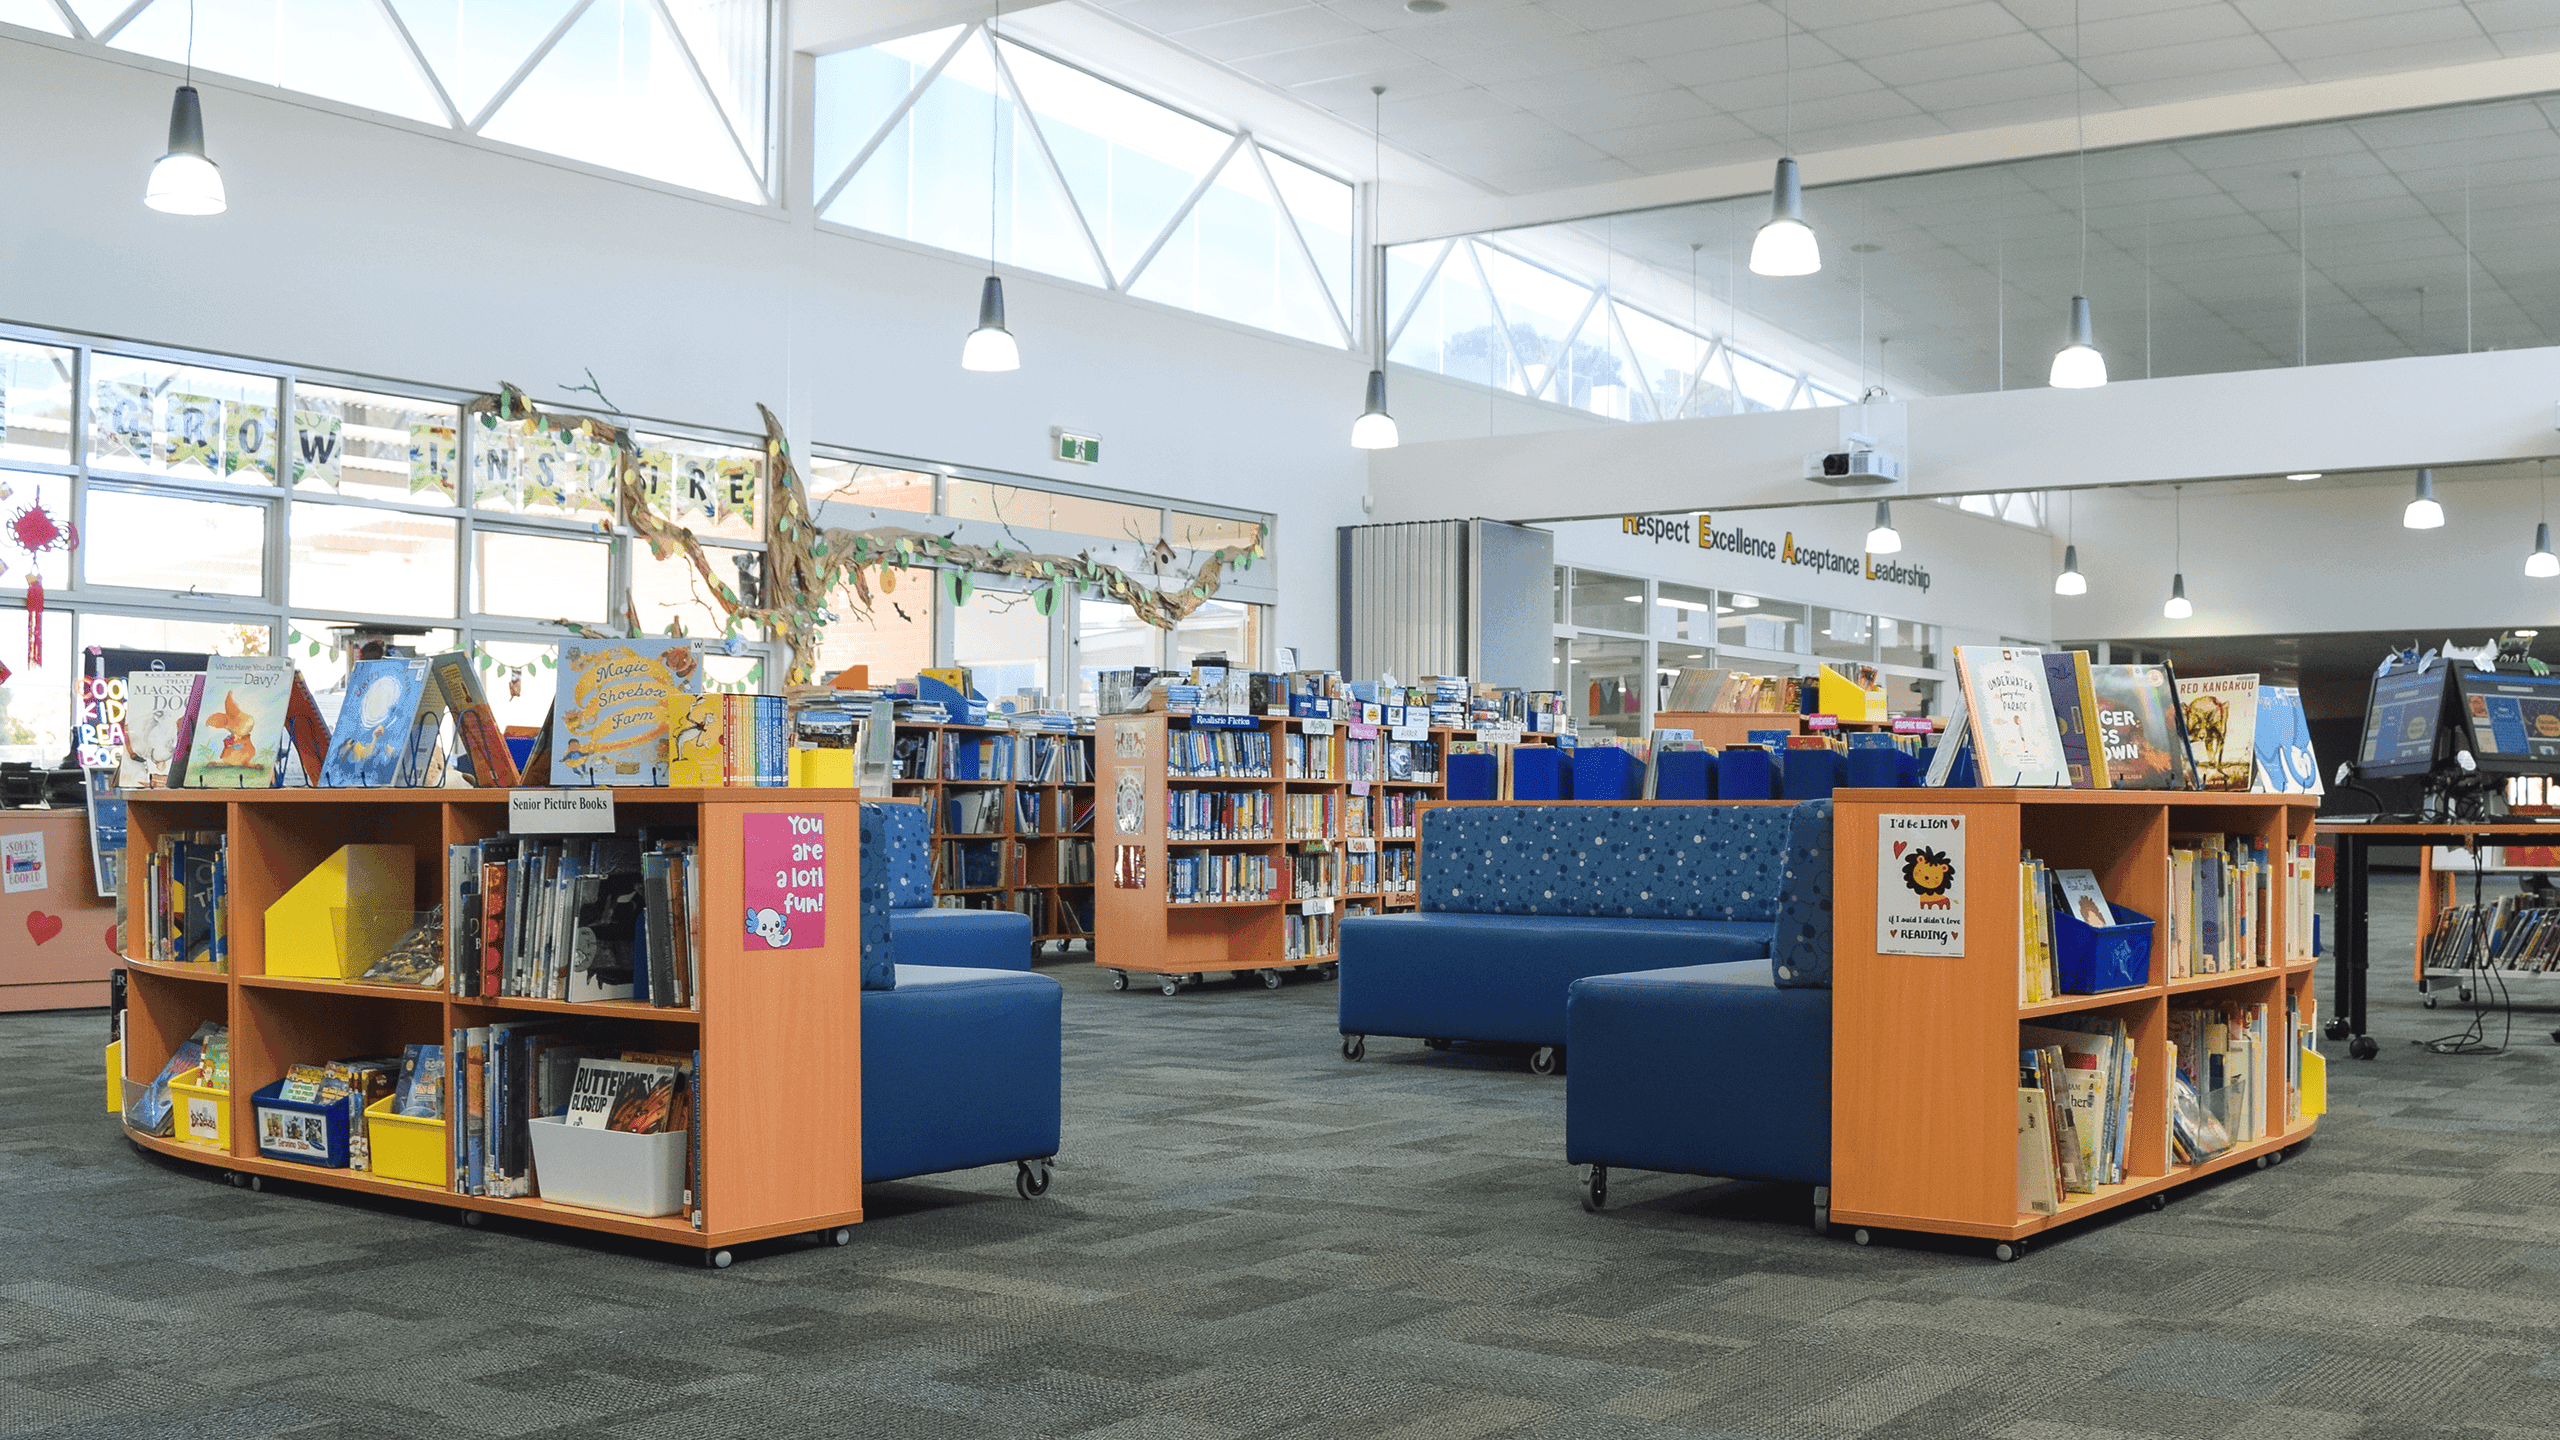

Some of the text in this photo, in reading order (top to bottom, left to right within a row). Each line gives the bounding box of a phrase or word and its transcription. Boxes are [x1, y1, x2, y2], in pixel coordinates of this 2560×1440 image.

[112, 398, 338, 465] GROW
[428, 441, 746, 505] INSPIRE
[1699, 514, 1776, 560] Excellence
[1781, 531, 1860, 576] Acceptance
[1865, 551, 1931, 594] Leadership
[215, 663, 234, 671] What
[234, 663, 251, 672] Have
[252, 664, 266, 672] You
[596, 660, 650, 683] Magic
[134, 684, 193, 695] MAGNE
[244, 673, 280, 688] Davy?
[1988, 675, 2034, 693] UNDERWATER
[2180, 682, 2199, 694] RED
[153, 694, 189, 711] DO
[598, 683, 667, 708] Shoebox
[79, 699, 128, 724] KID
[2002, 701, 2028, 712] PARADE
[612, 711, 655, 730] Farm
[1196, 715, 1251, 725] Realistic Fiction
[2100, 710, 2137, 726] GER
[79, 723, 125, 746] REA
[79, 744, 123, 768] BOO
[2104, 743, 2139, 760] OWN
[512, 796, 608, 811] Senior Picture Books
[787, 815, 823, 835] You
[1890, 818, 1948, 829] I'd be LION
[792, 842, 824, 862] are
[776, 870, 787, 888] a
[783, 892, 824, 914] fun!
[1888, 915, 1895, 925] if
[1901, 915, 1917, 924] said
[1923, 916, 1945, 924] didn't
[1946, 915, 1961, 925] love
[1900, 929, 1948, 946] READING
[571, 1094, 608, 1114] CLOSEUP
